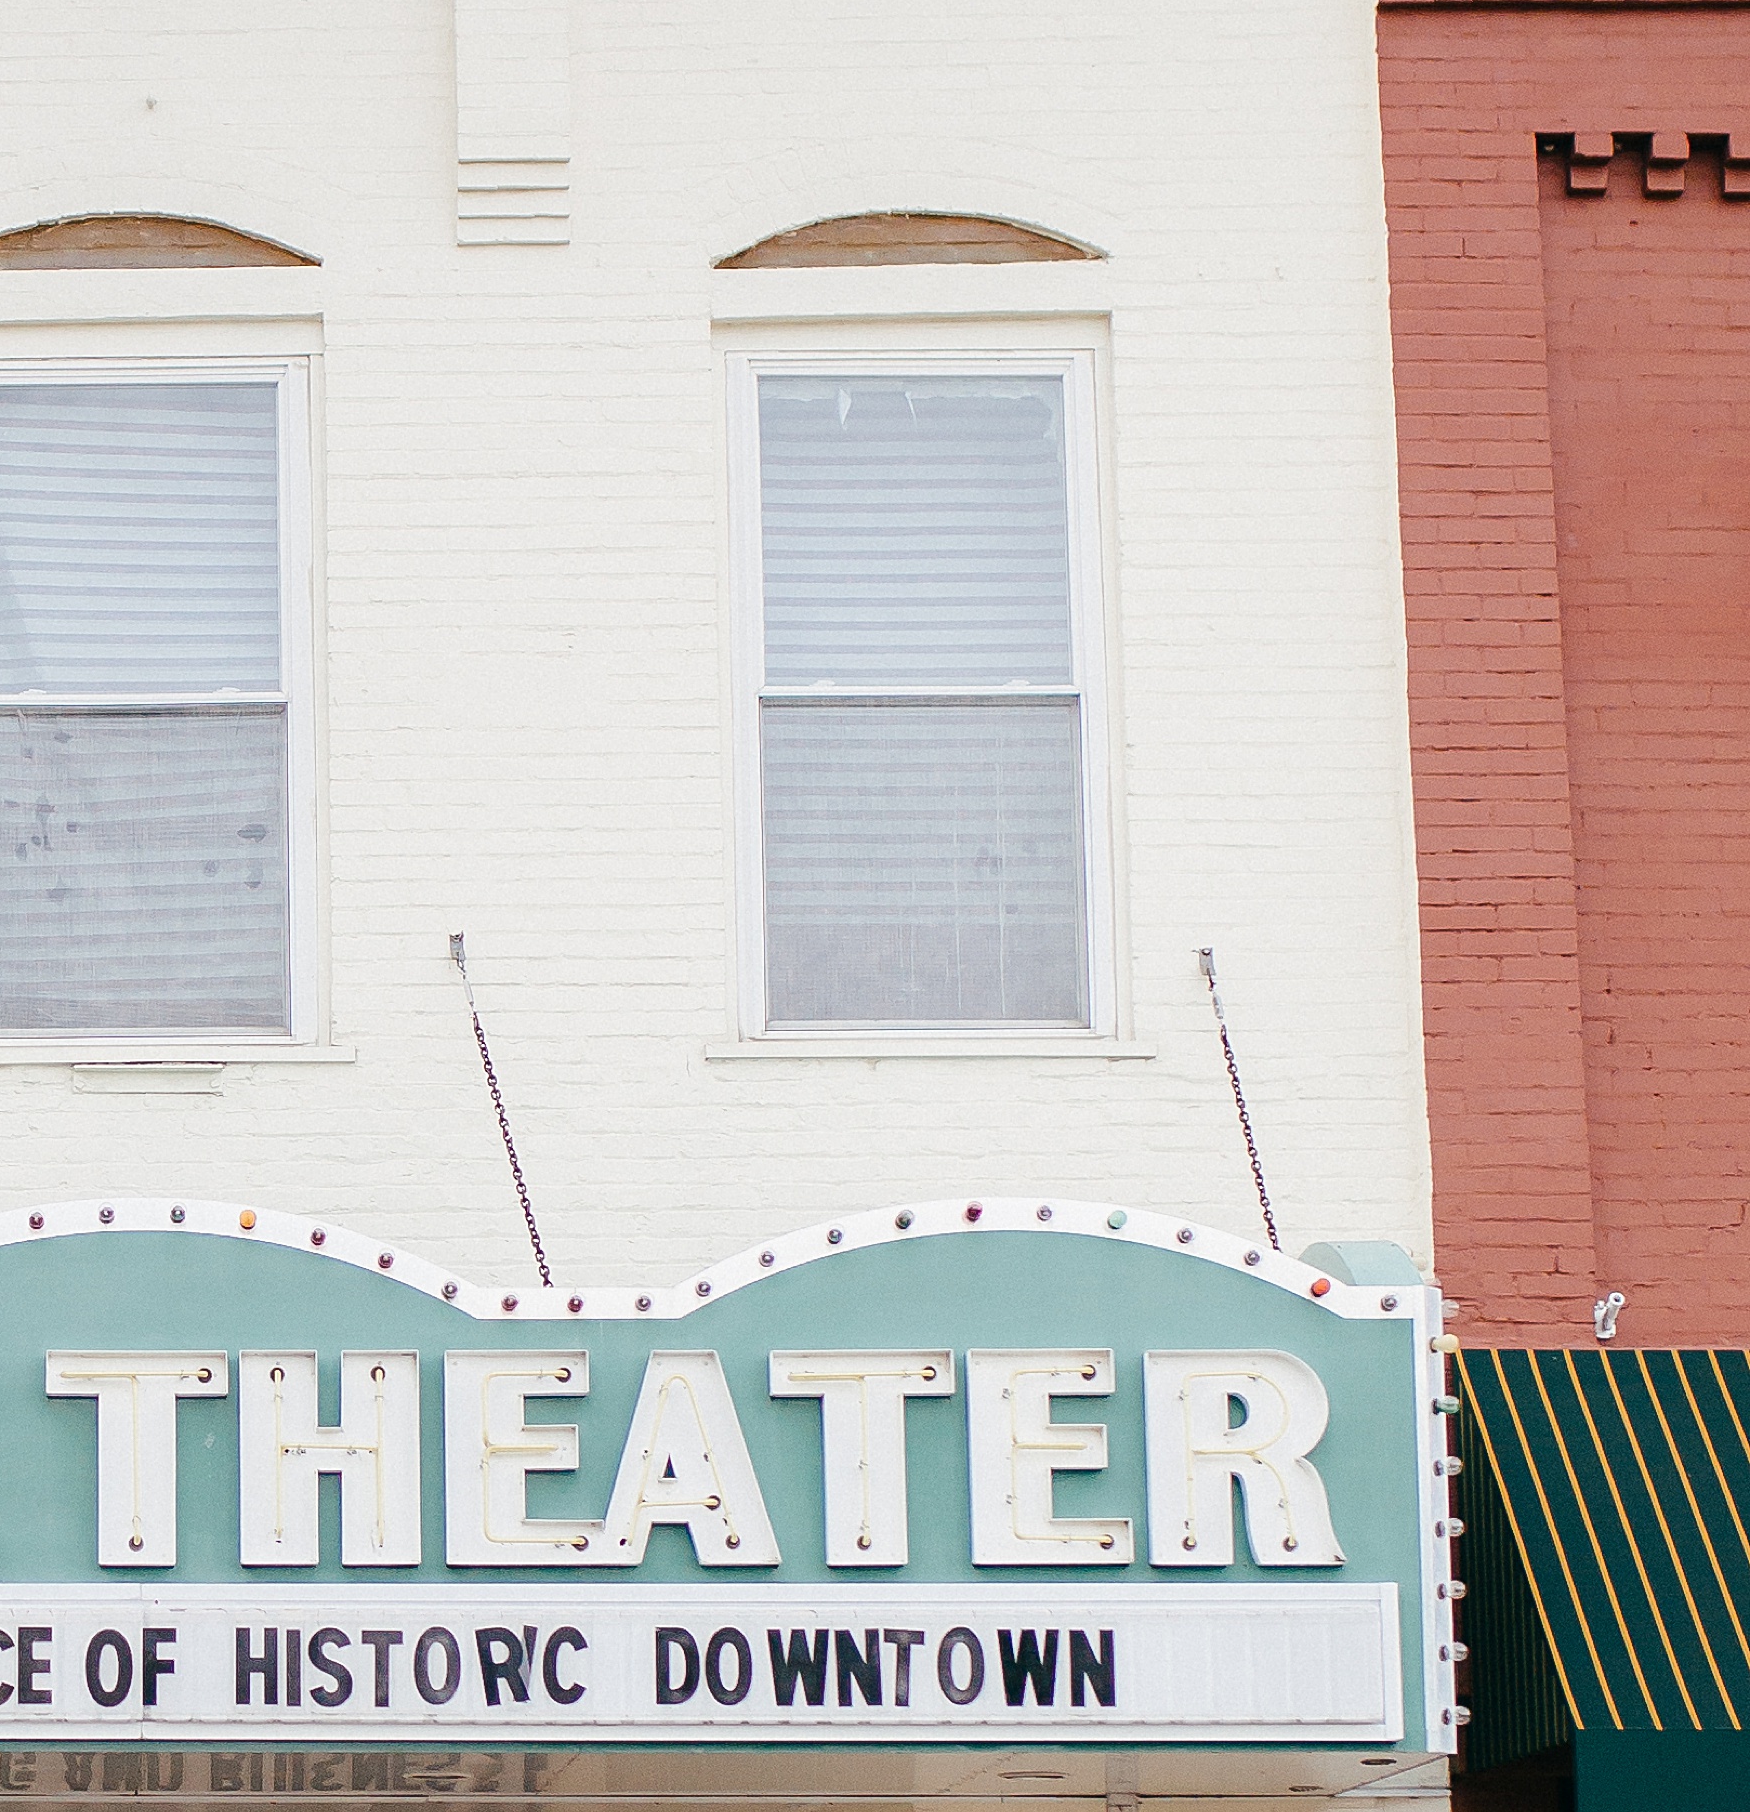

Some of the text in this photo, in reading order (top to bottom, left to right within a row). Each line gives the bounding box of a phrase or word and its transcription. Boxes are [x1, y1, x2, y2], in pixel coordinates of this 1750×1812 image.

[47, 1348, 1346, 1569] THEATER
[85, 1626, 177, 1708] OF
[655, 1626, 1117, 1708] DOWNTOWN
